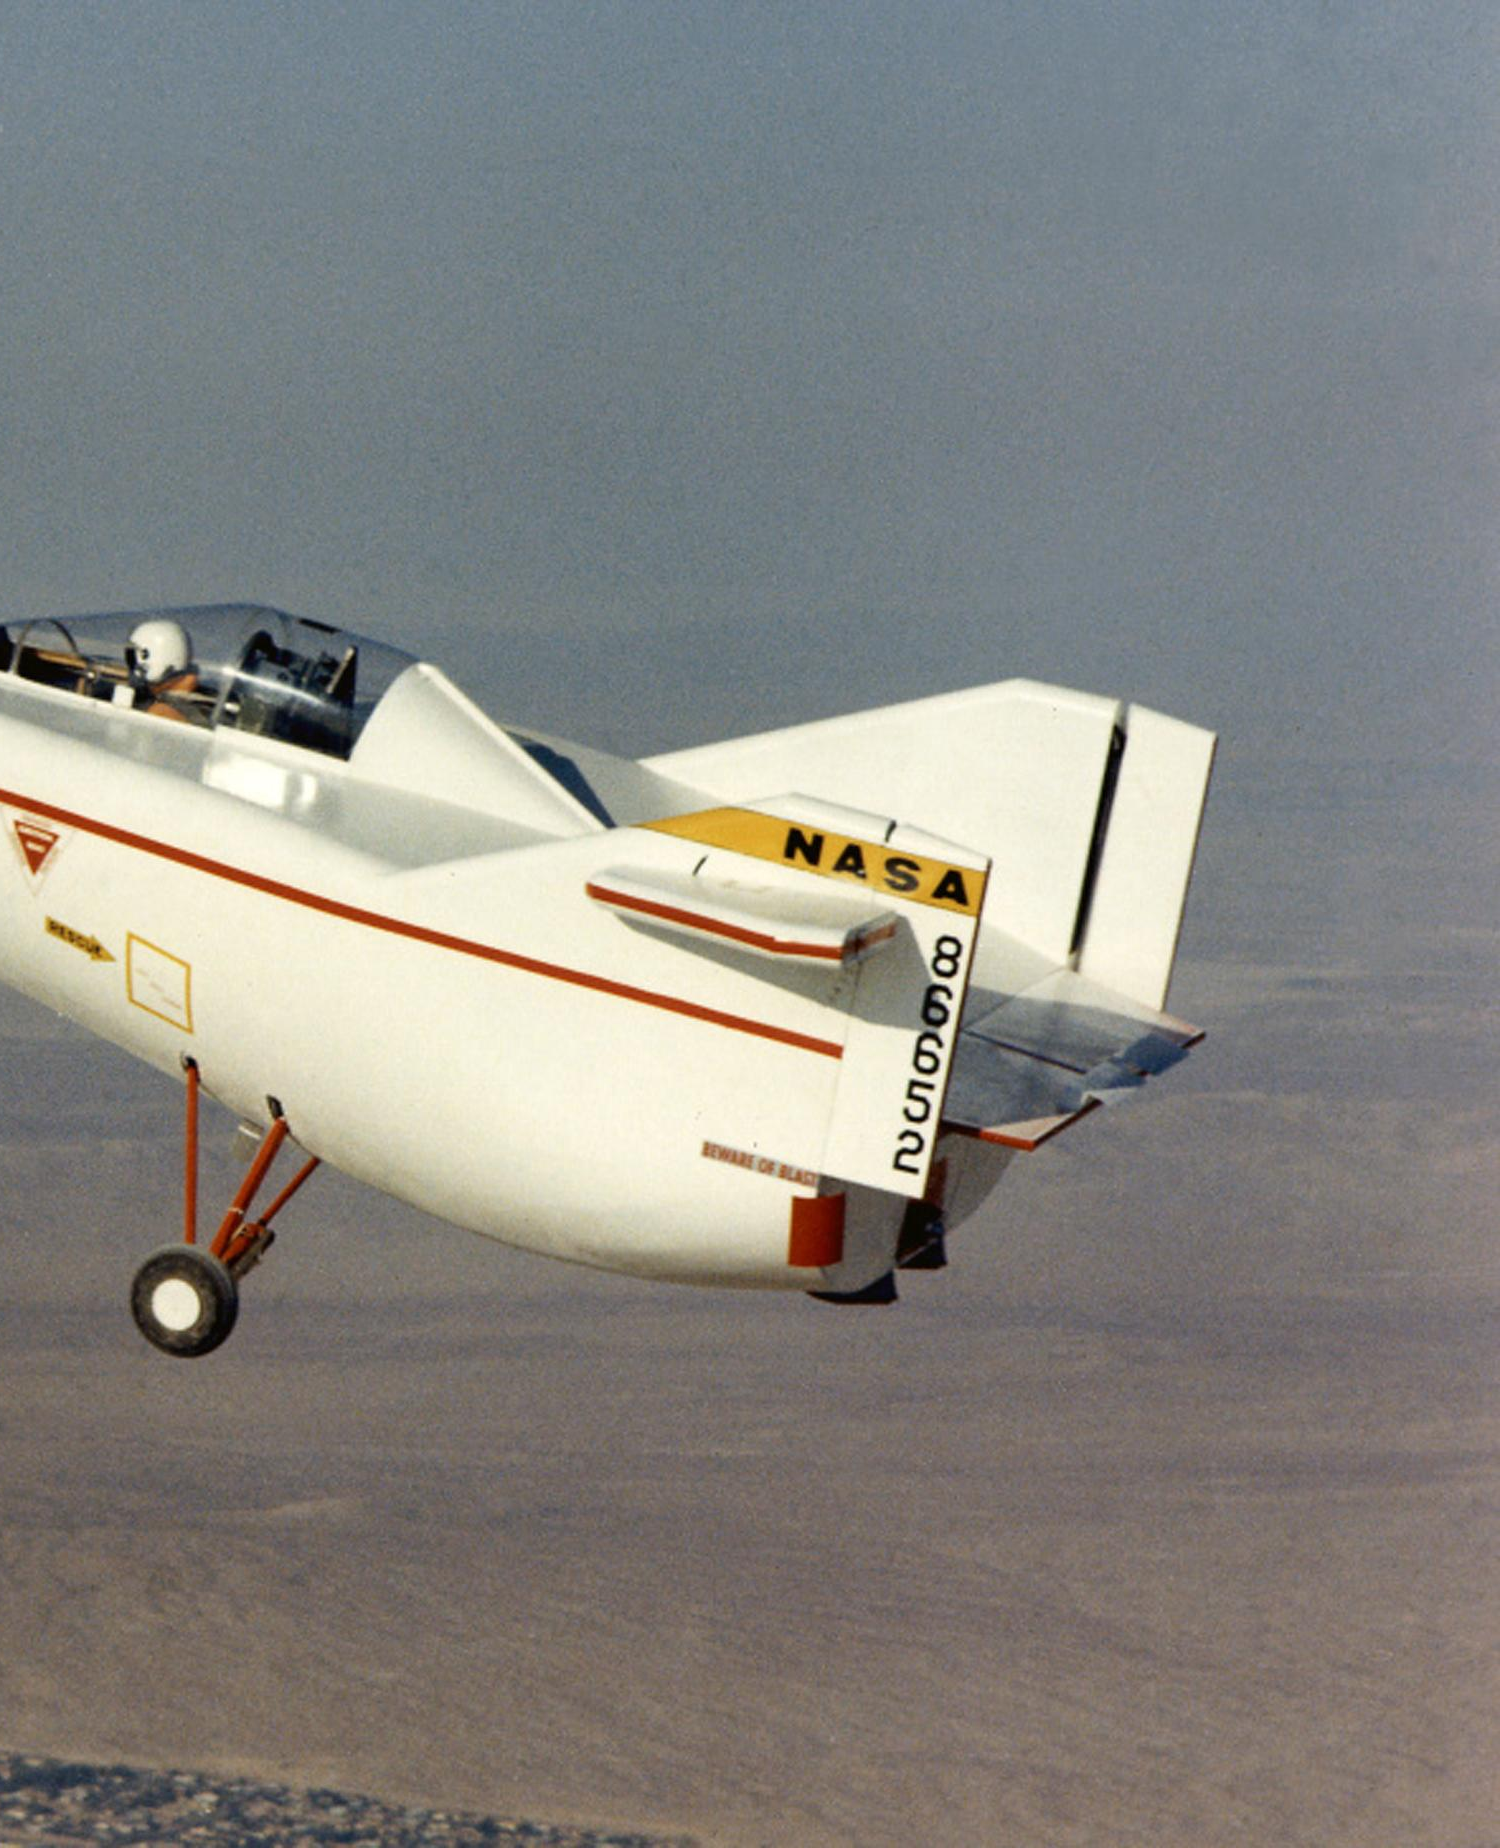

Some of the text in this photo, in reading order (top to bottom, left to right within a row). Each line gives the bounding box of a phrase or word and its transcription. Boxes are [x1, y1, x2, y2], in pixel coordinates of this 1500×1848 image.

[784, 827, 970, 906] NASA
[893, 935, 963, 1174] 86652
[702, 1141, 755, 1170] BEWARE
[757, 1157, 776, 1176] OF
